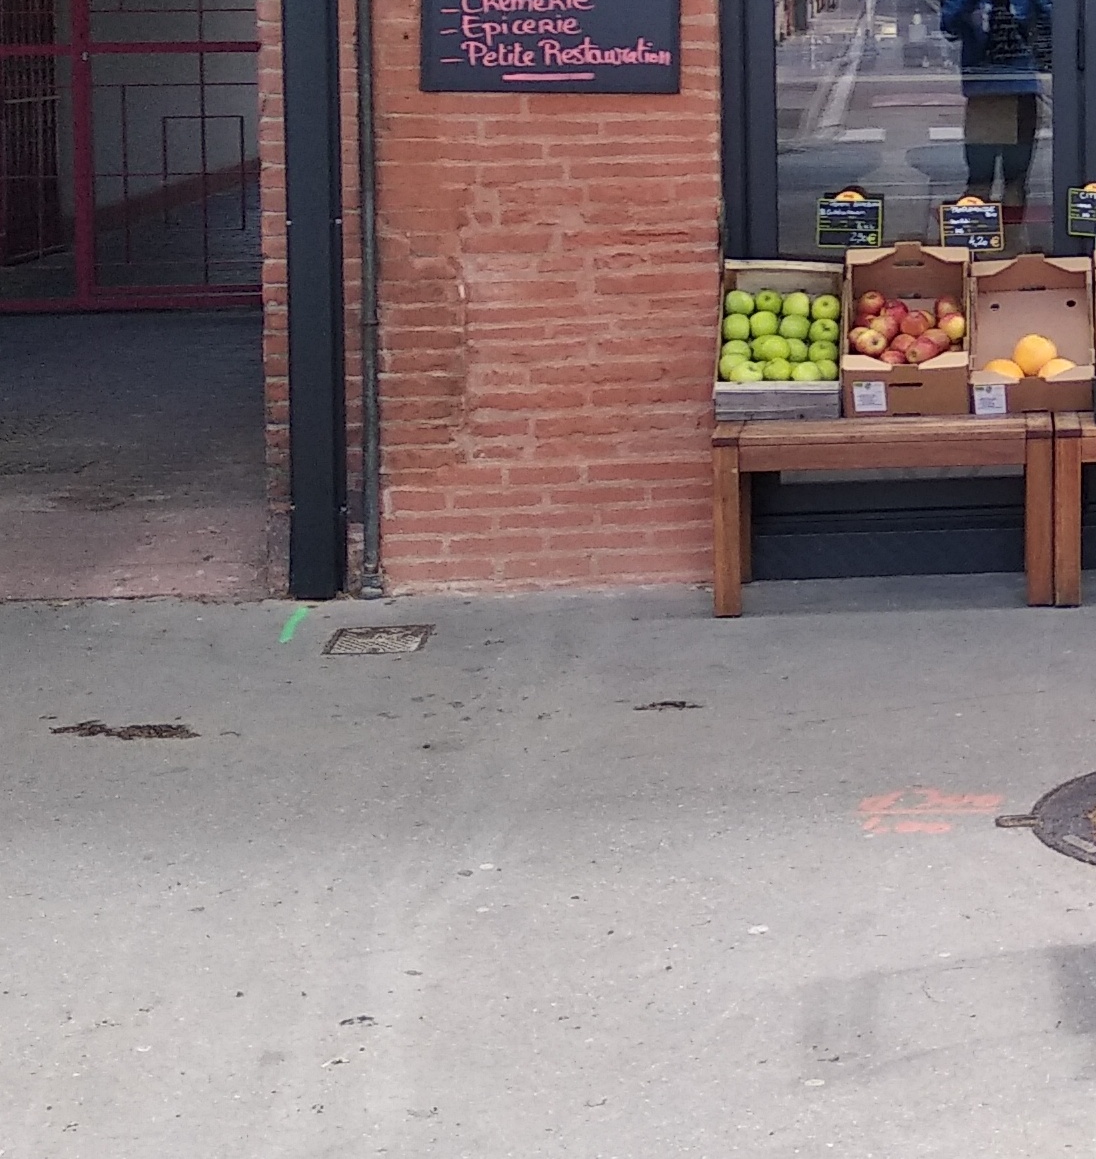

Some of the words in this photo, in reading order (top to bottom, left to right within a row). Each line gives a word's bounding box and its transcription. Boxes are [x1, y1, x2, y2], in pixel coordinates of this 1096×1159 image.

[461, 14, 583, 46] Epicerie
[460, 40, 537, 68] Petite
[537, 36, 672, 69] Restauration
